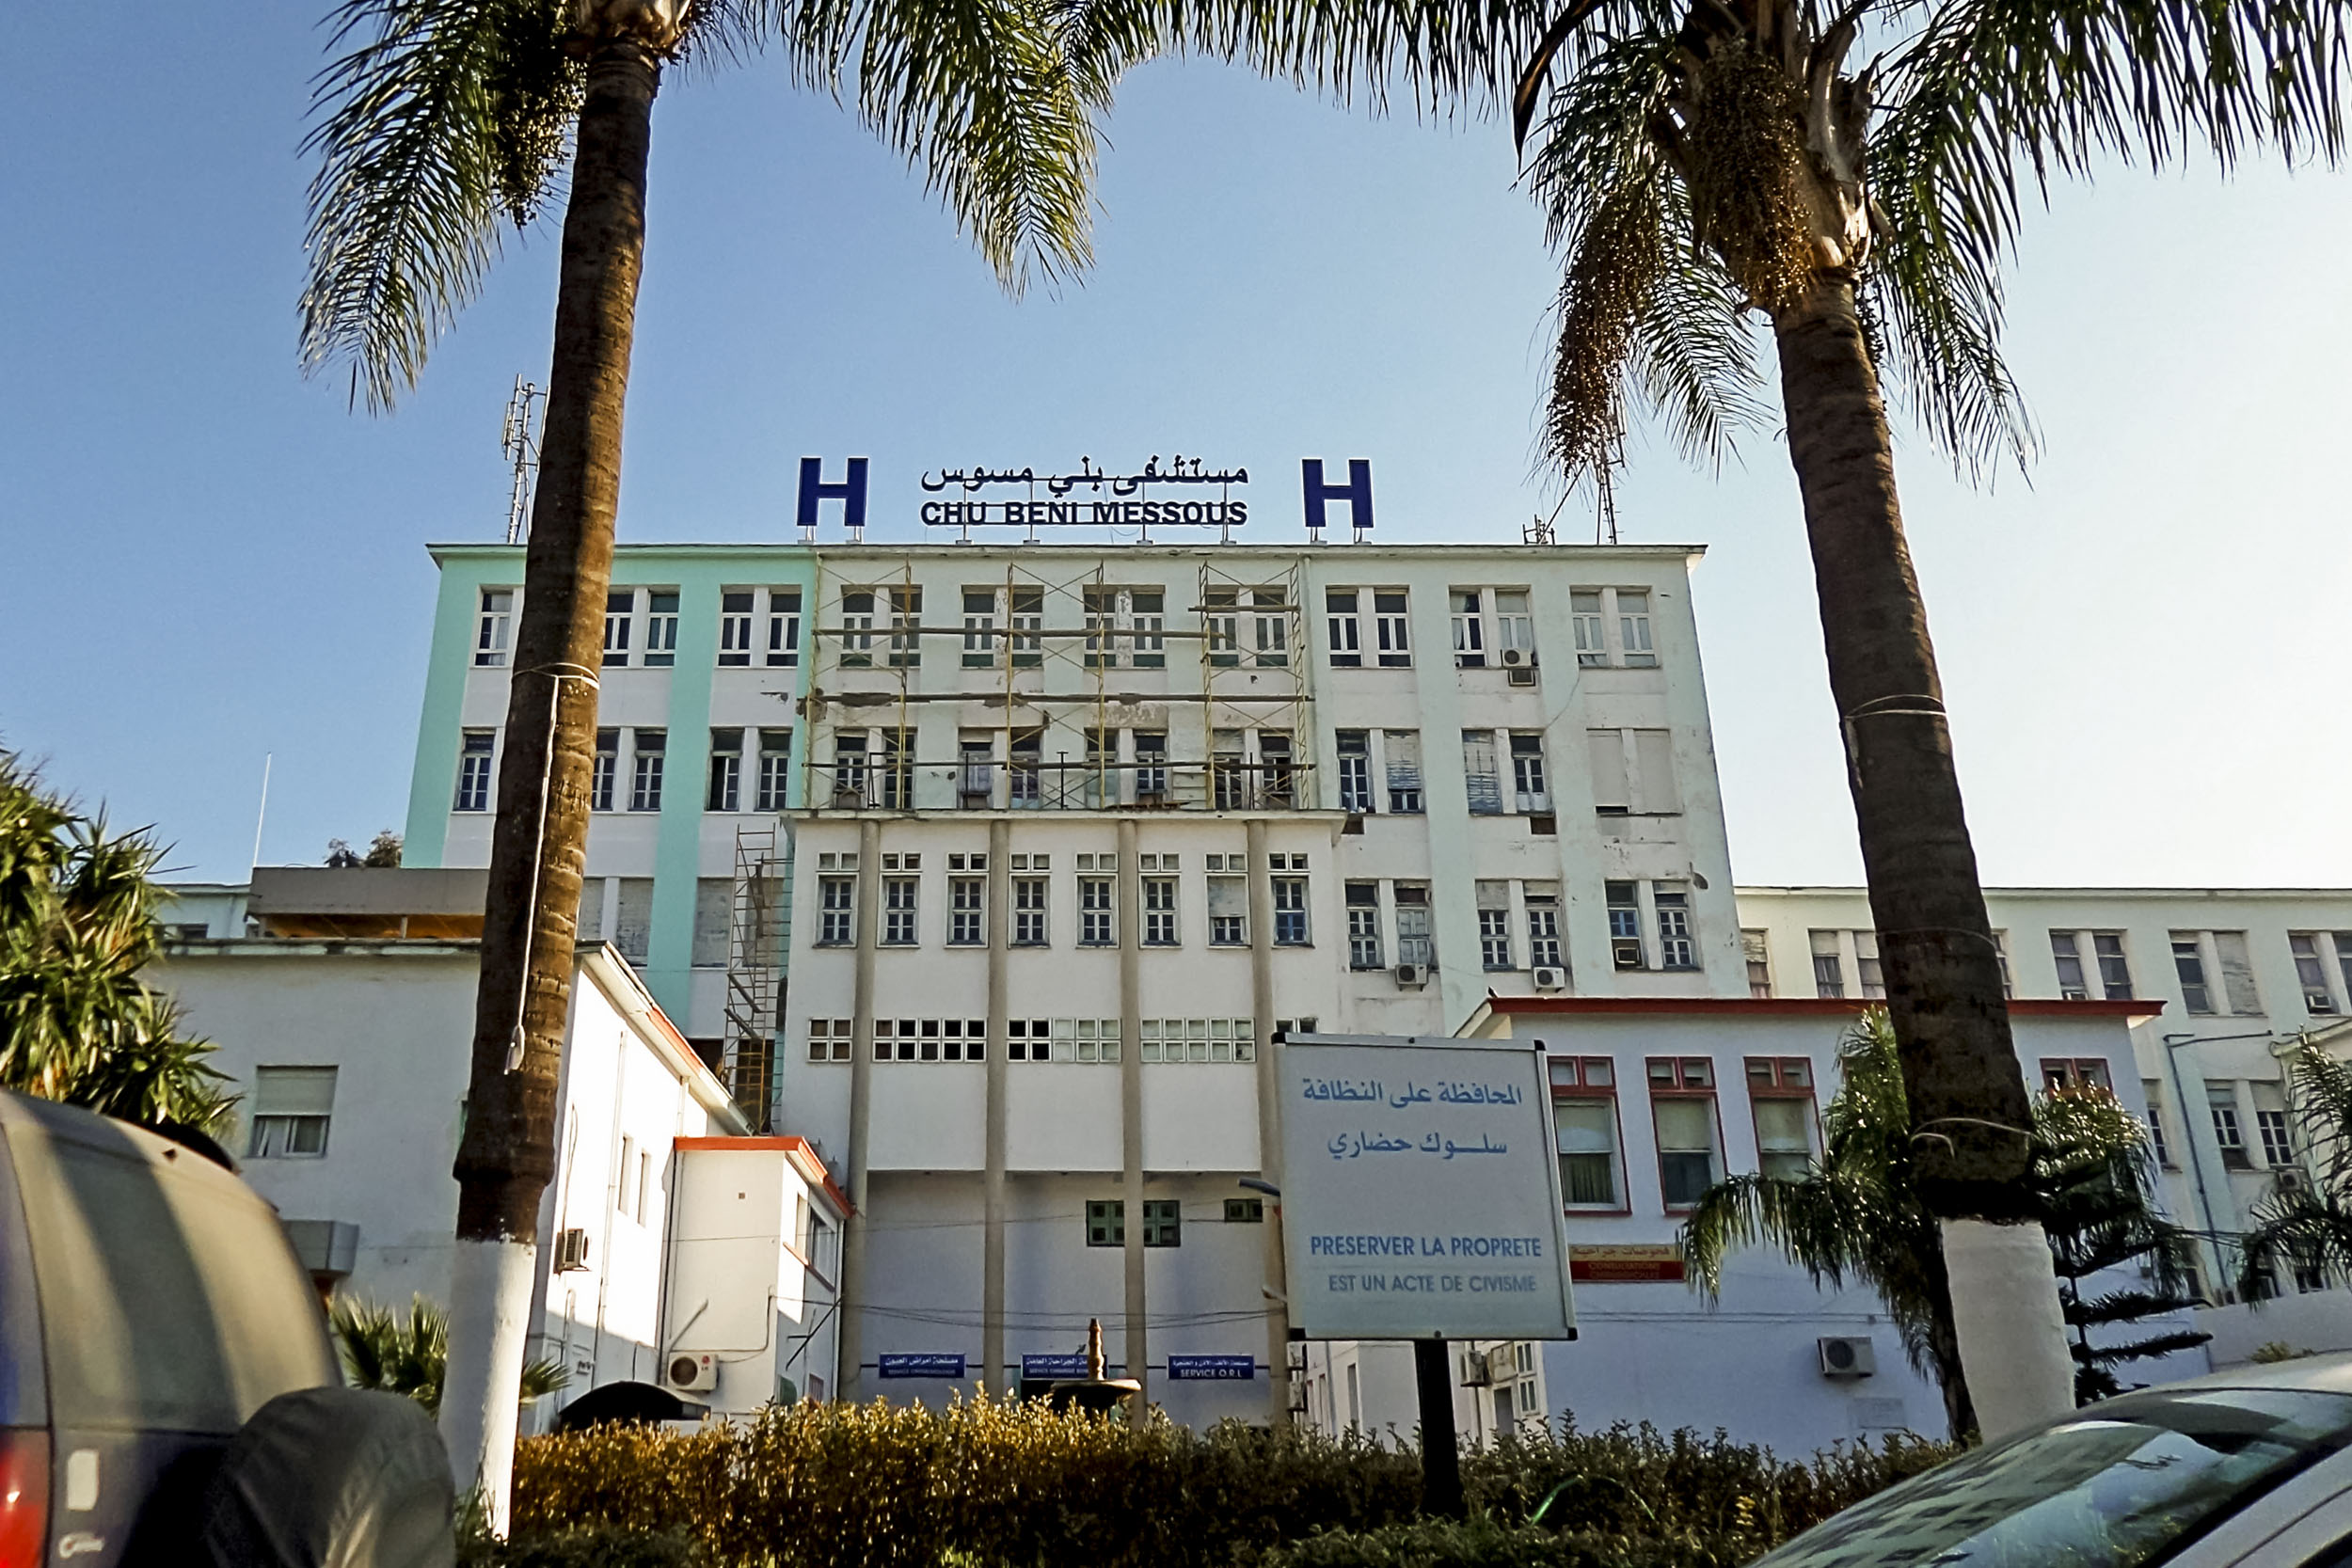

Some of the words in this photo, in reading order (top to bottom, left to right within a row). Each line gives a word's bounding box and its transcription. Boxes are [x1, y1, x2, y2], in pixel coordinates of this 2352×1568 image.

[921, 467, 1033, 492] مسوس
[1048, 456, 1103, 499] بني
[1113, 454, 1248, 496] مستشفى
[797, 457, 869, 527] H
[1302, 459, 1375, 528] H
[921, 501, 986, 526] CHU
[1005, 501, 1077, 525] BENI
[1092, 501, 1248, 525] MESSOUS
[1303, 1078, 1382, 1101] النظافة
[1390, 1082, 1431, 1108] على
[1438, 1082, 1521, 1104] المحافظة
[1327, 1131, 1412, 1160] حضاري
[1311, 1236, 1415, 1257] PRESERVER
[1422, 1237, 1445, 1257] LA
[1451, 1238, 1541, 1257] PROPRETE
[1328, 1275, 1356, 1291] EST
[1361, 1275, 1385, 1291] UN
[1391, 1275, 1435, 1292] ACTE
[1441, 1275, 1463, 1292] DE
[1469, 1275, 1536, 1292] CIVISME
[1181, 1369, 1216, 1377] SERVICE
